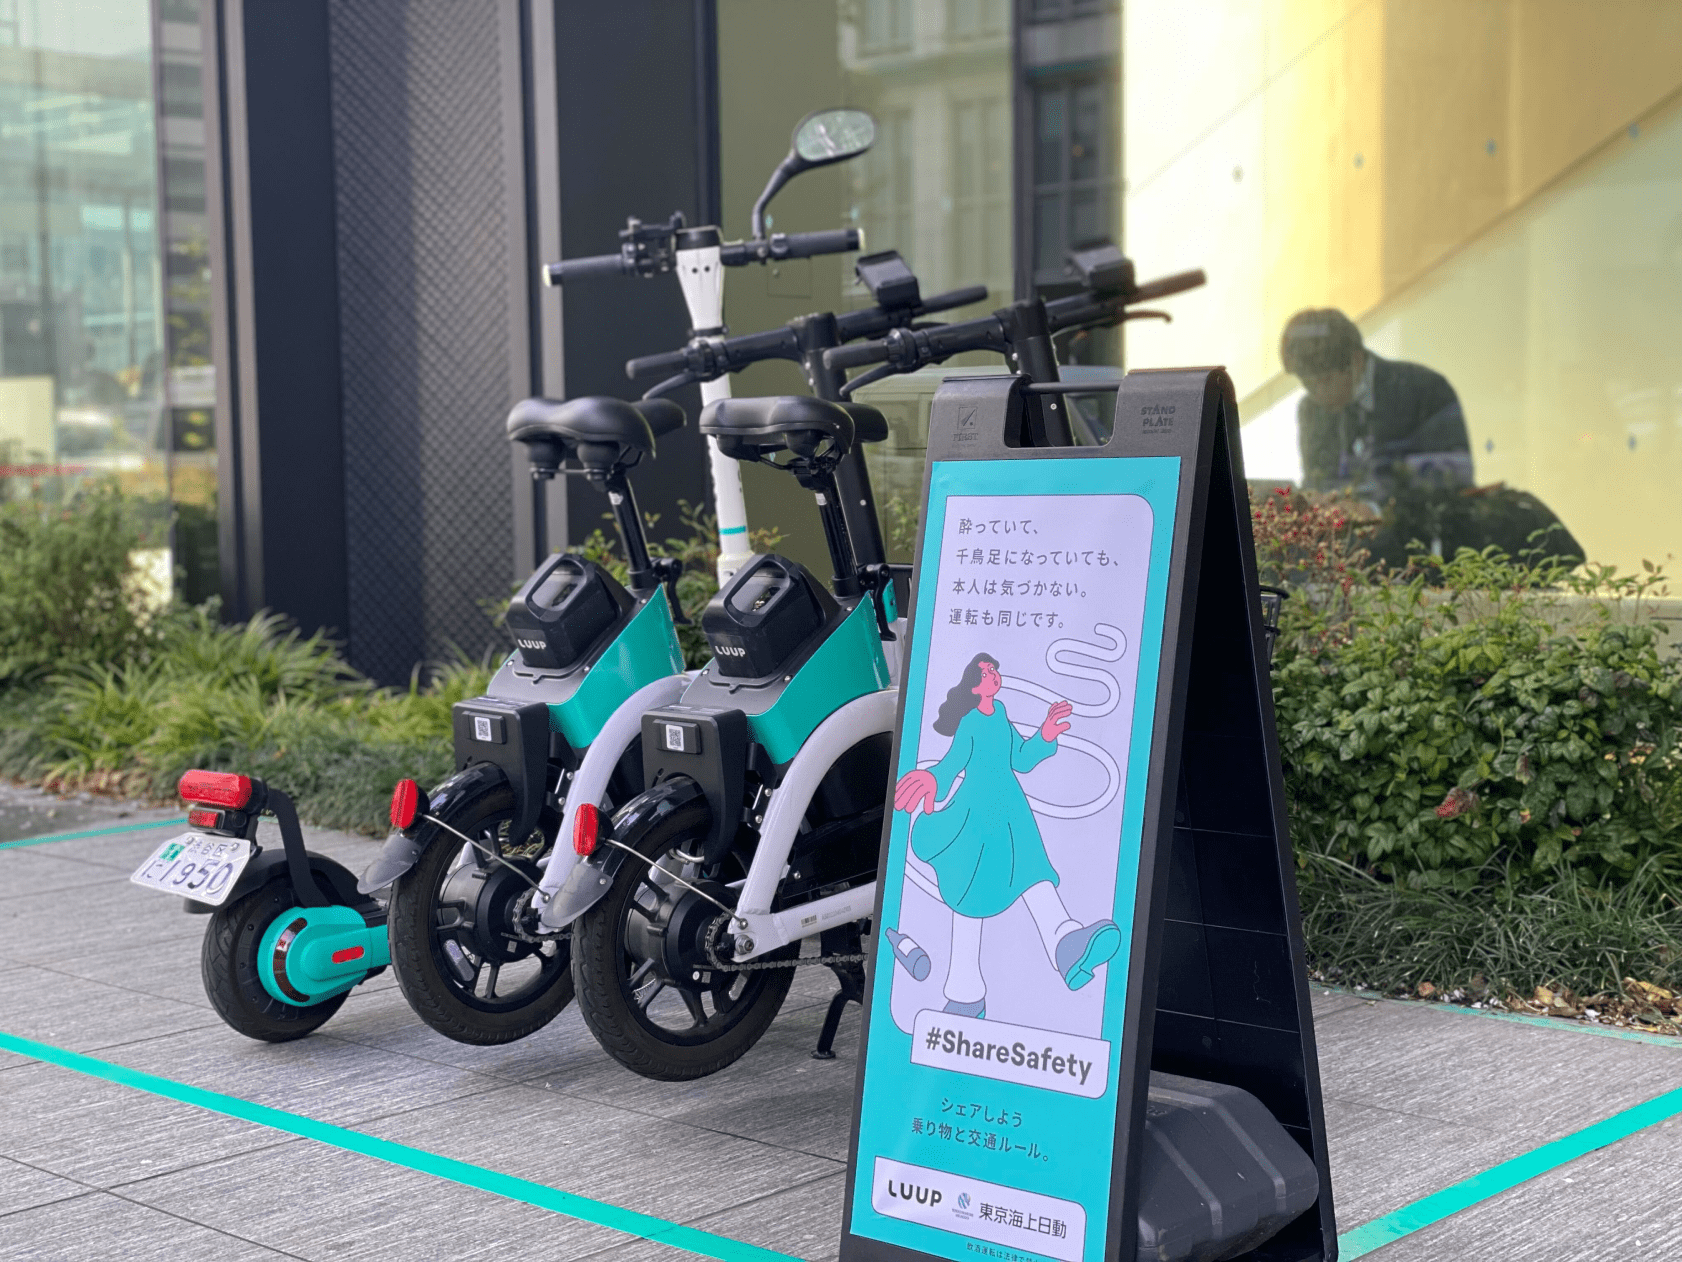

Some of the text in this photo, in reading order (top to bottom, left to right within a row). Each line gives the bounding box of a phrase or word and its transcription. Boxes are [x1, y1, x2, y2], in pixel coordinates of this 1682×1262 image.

[958, 518, 1039, 535] 酔っていて、
[955, 548, 1119, 567] 千鳥足になっていても、
[952, 578, 1087, 598] 本人は気づかない。
[948, 608, 1064, 629] 運転も同じです。
[517, 638, 547, 650] LUUP
[714, 645, 746, 658] LUUP
[926, 1026, 1093, 1086] #ShareSafety
[941, 1098, 1023, 1128] シェアしよう
[911, 1117, 1049, 1163] 乗り物と交通ルール。
[888, 1180, 943, 1208] LUUP
[978, 1202, 1067, 1240] 東京海上日動
[966, 1241, 1038, 1262] 飲酒運転は法律で
